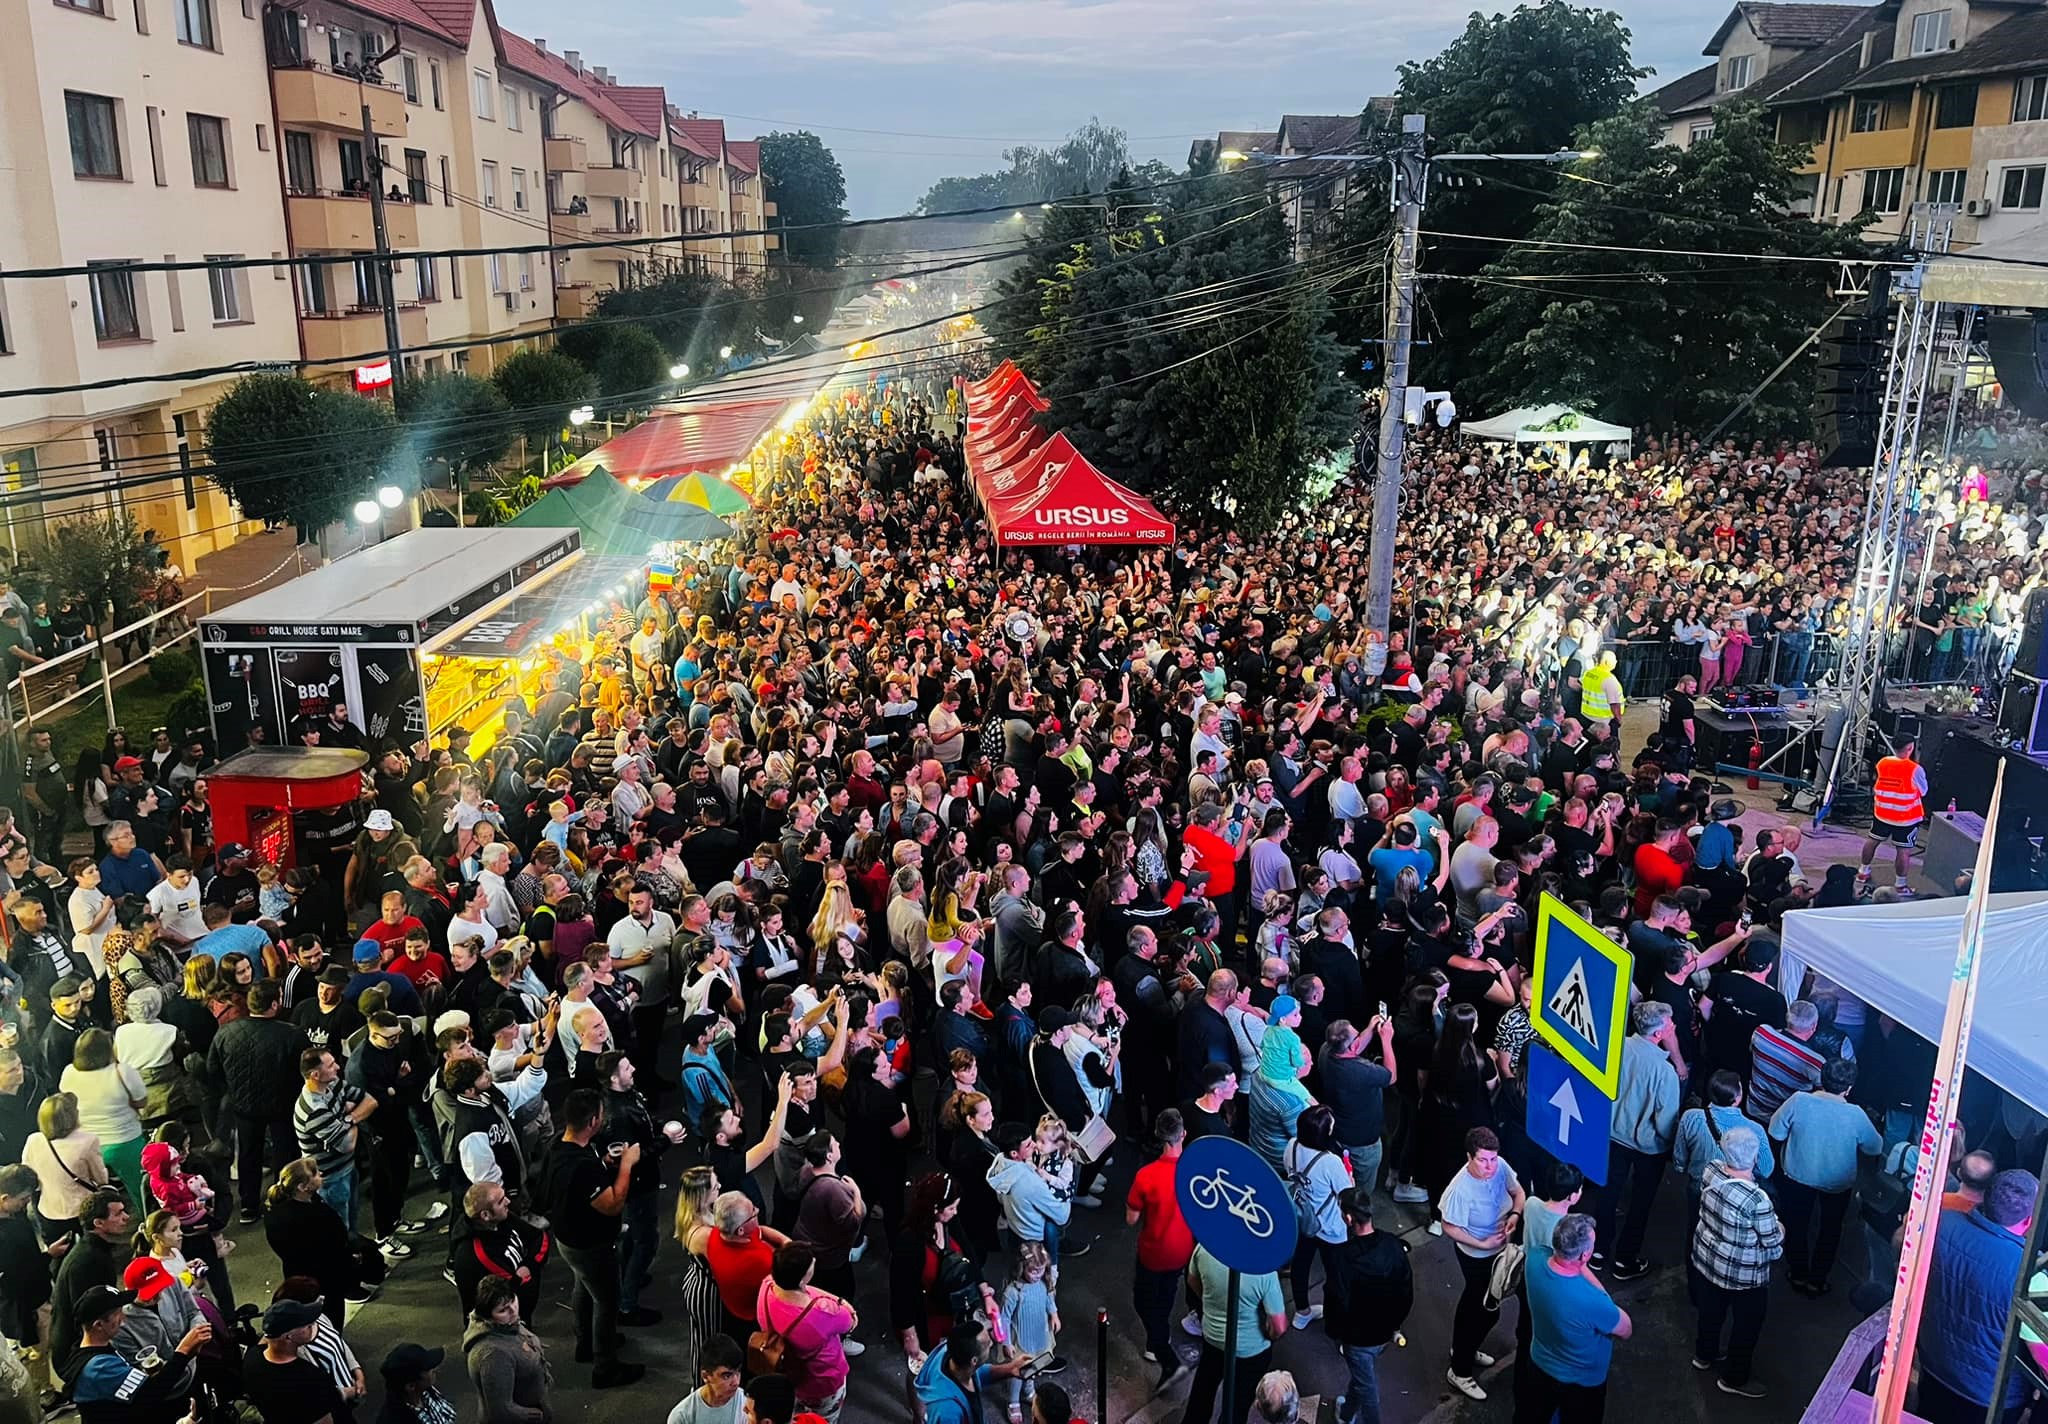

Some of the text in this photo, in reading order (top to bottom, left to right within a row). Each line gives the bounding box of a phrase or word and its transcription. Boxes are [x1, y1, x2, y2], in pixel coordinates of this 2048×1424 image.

[1035, 506, 1128, 526] URSUS
[1004, 531, 1034, 541] URSUS
[1038, 532, 1064, 540] REGELE
[1066, 531, 1085, 539] BERII
[1136, 529, 1166, 540] URSUS
[268, 626, 291, 636] GRILL
[293, 626, 319, 636] HOUSE
[320, 626, 339, 636] SATU
[340, 626, 363, 636] MARE
[461, 621, 525, 642] BBQ
[298, 683, 330, 699] BBQ
